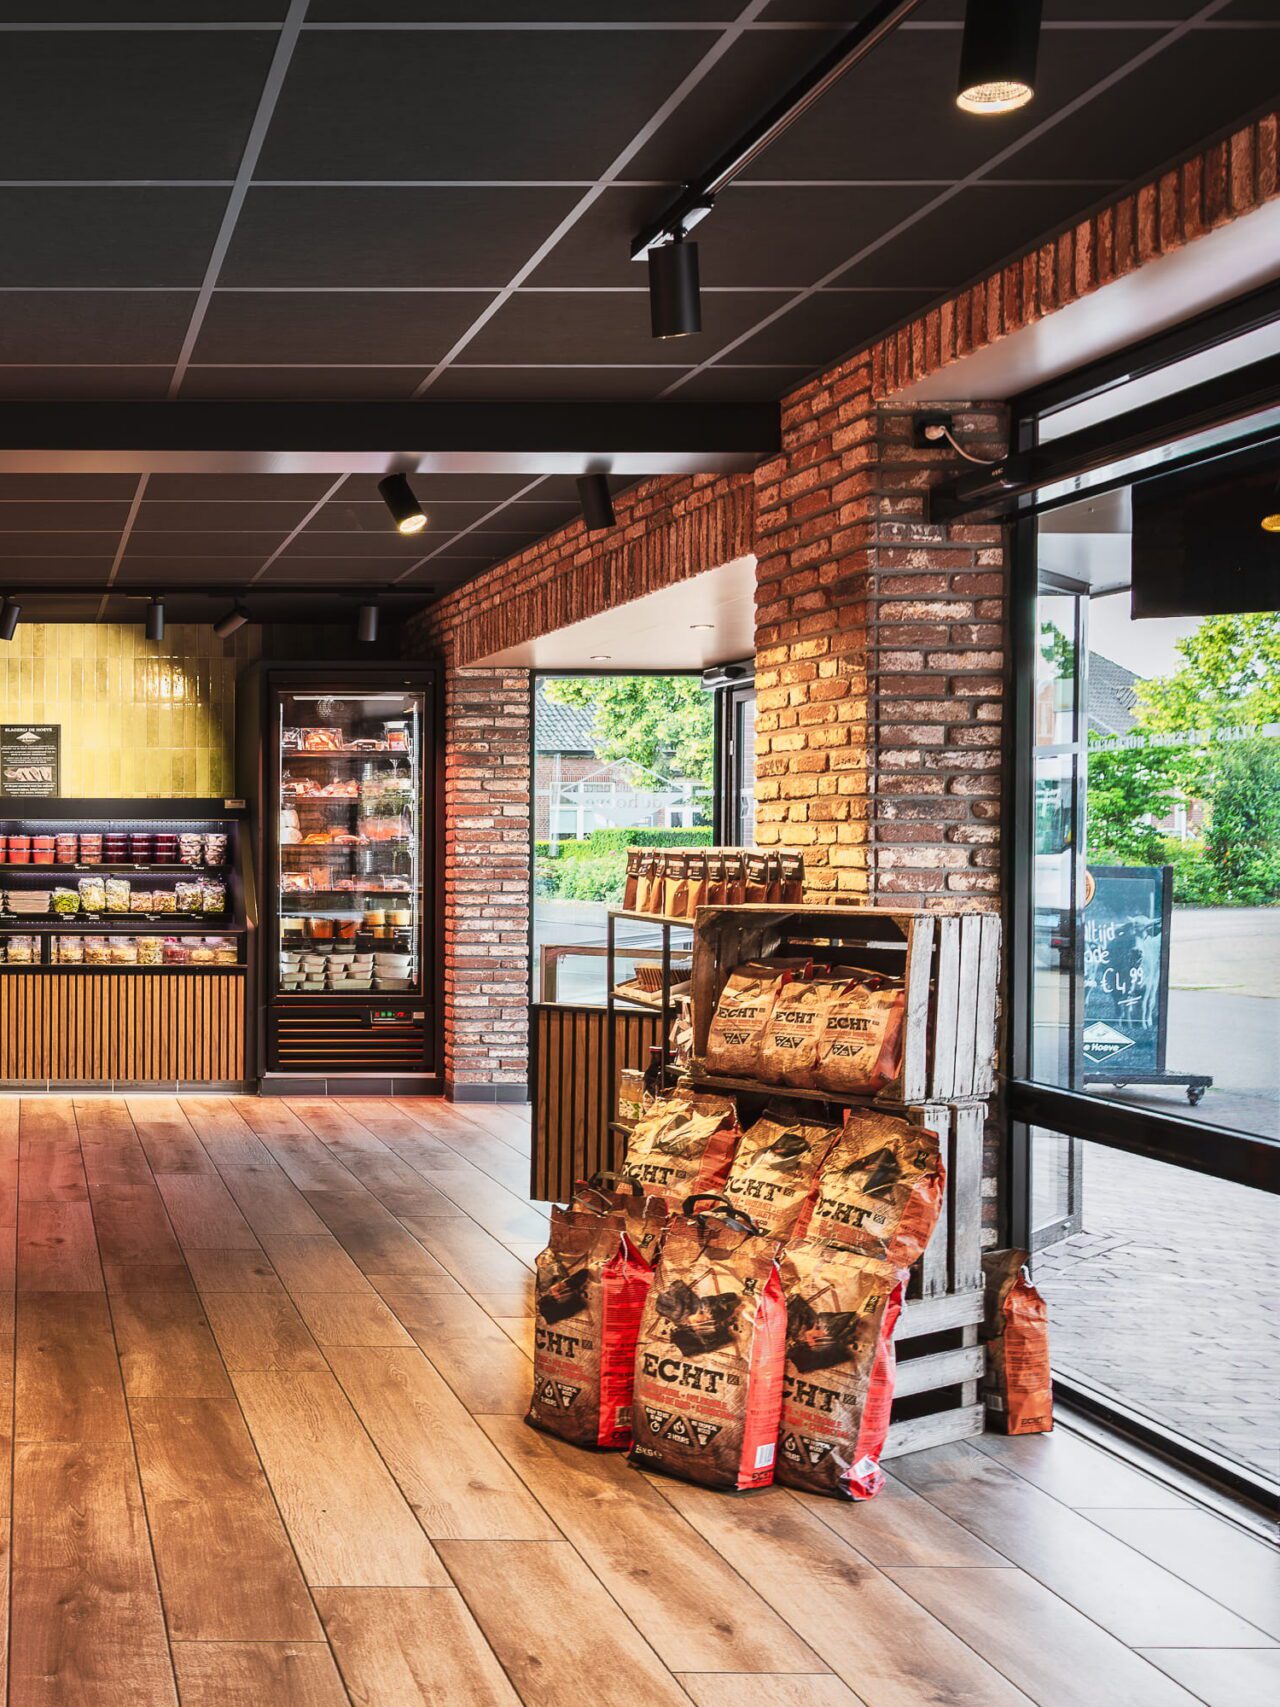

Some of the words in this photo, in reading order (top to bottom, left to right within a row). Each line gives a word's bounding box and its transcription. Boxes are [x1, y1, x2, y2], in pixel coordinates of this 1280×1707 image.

[718, 1007, 758, 1018] ECHT
[775, 1011, 816, 1024] ECHT
[826, 1017, 871, 1031] ECHT
[816, 1197, 873, 1228] CHT
[536, 1328, 579, 1359] CHT
[642, 1352, 724, 1394] ECHT
[782, 1374, 841, 1412] CHT
